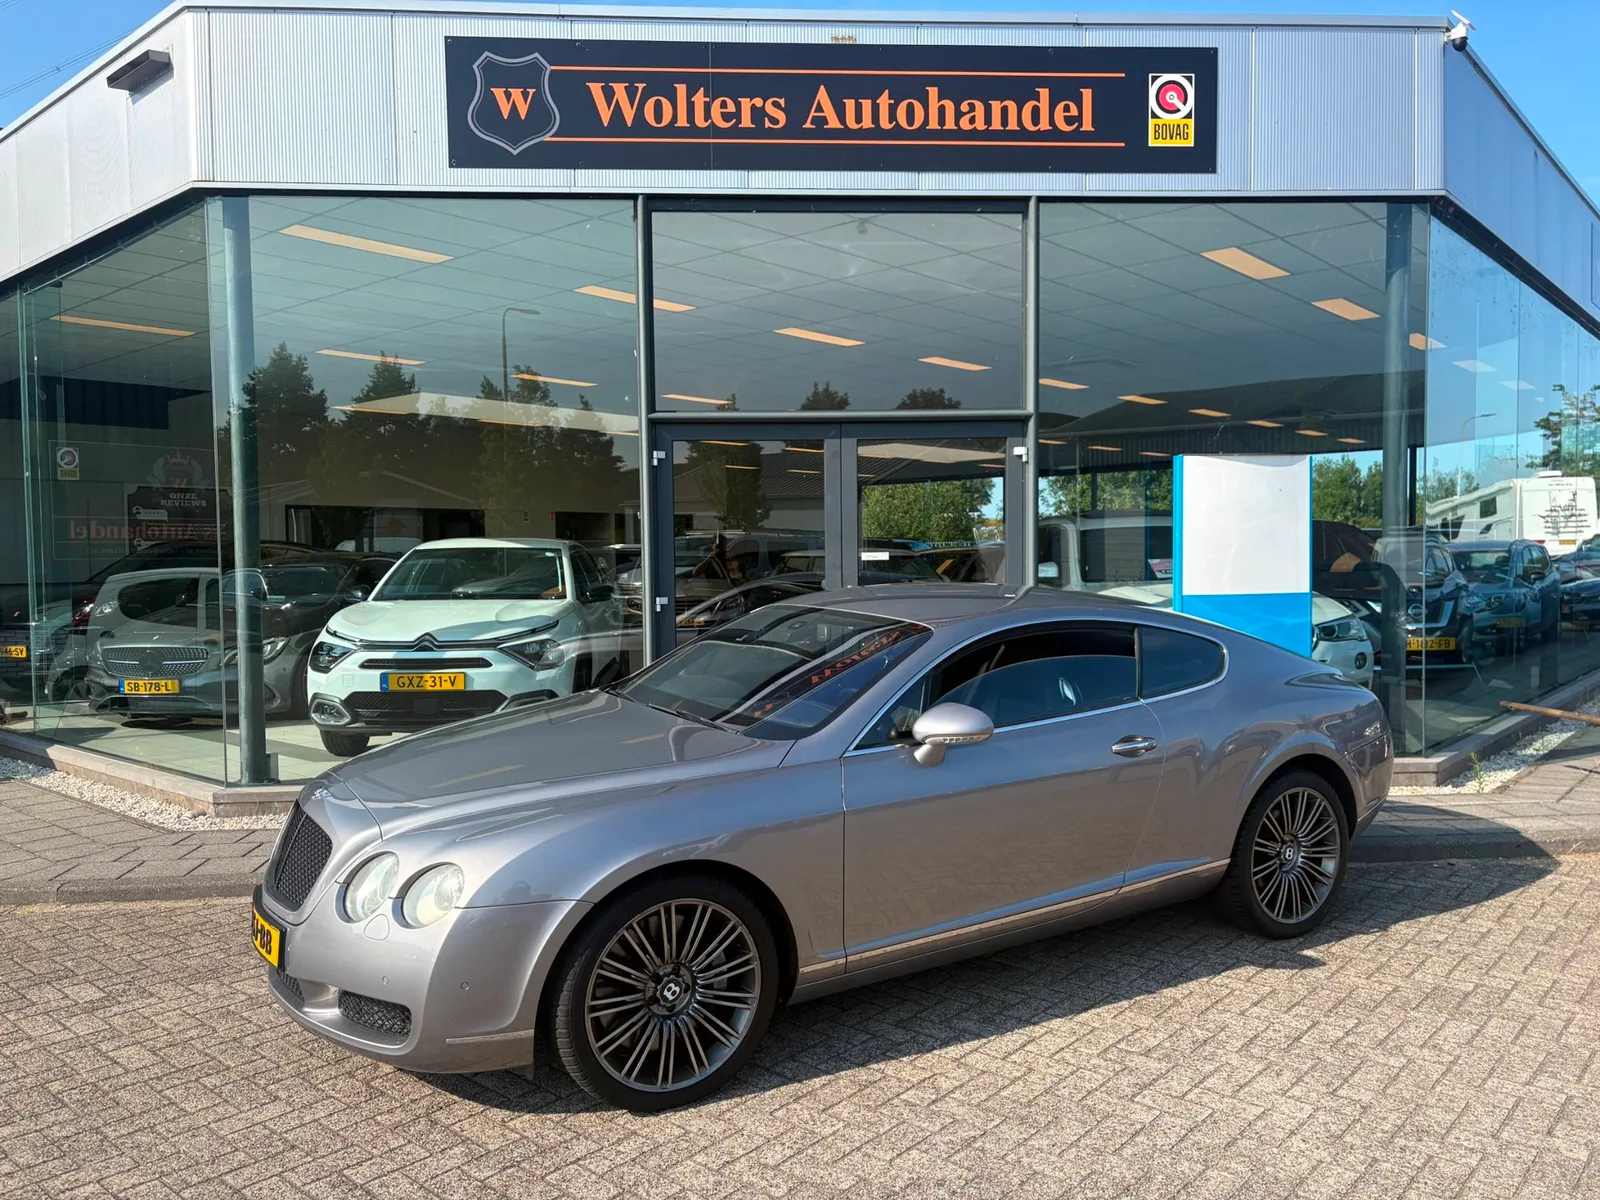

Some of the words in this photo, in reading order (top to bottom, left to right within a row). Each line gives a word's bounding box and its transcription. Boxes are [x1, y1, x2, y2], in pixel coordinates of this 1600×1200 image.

[490, 87, 537, 120] W
[585, 82, 788, 130] Wolters
[802, 84, 1096, 132] Autohandel
[1153, 123, 1190, 141] BOVAG
[169, 492, 198, 500] ONZE
[160, 499, 208, 507] REVIEWS
[127, 681, 172, 692] SB-178-L
[396, 675, 457, 688] GXZ-31-V
